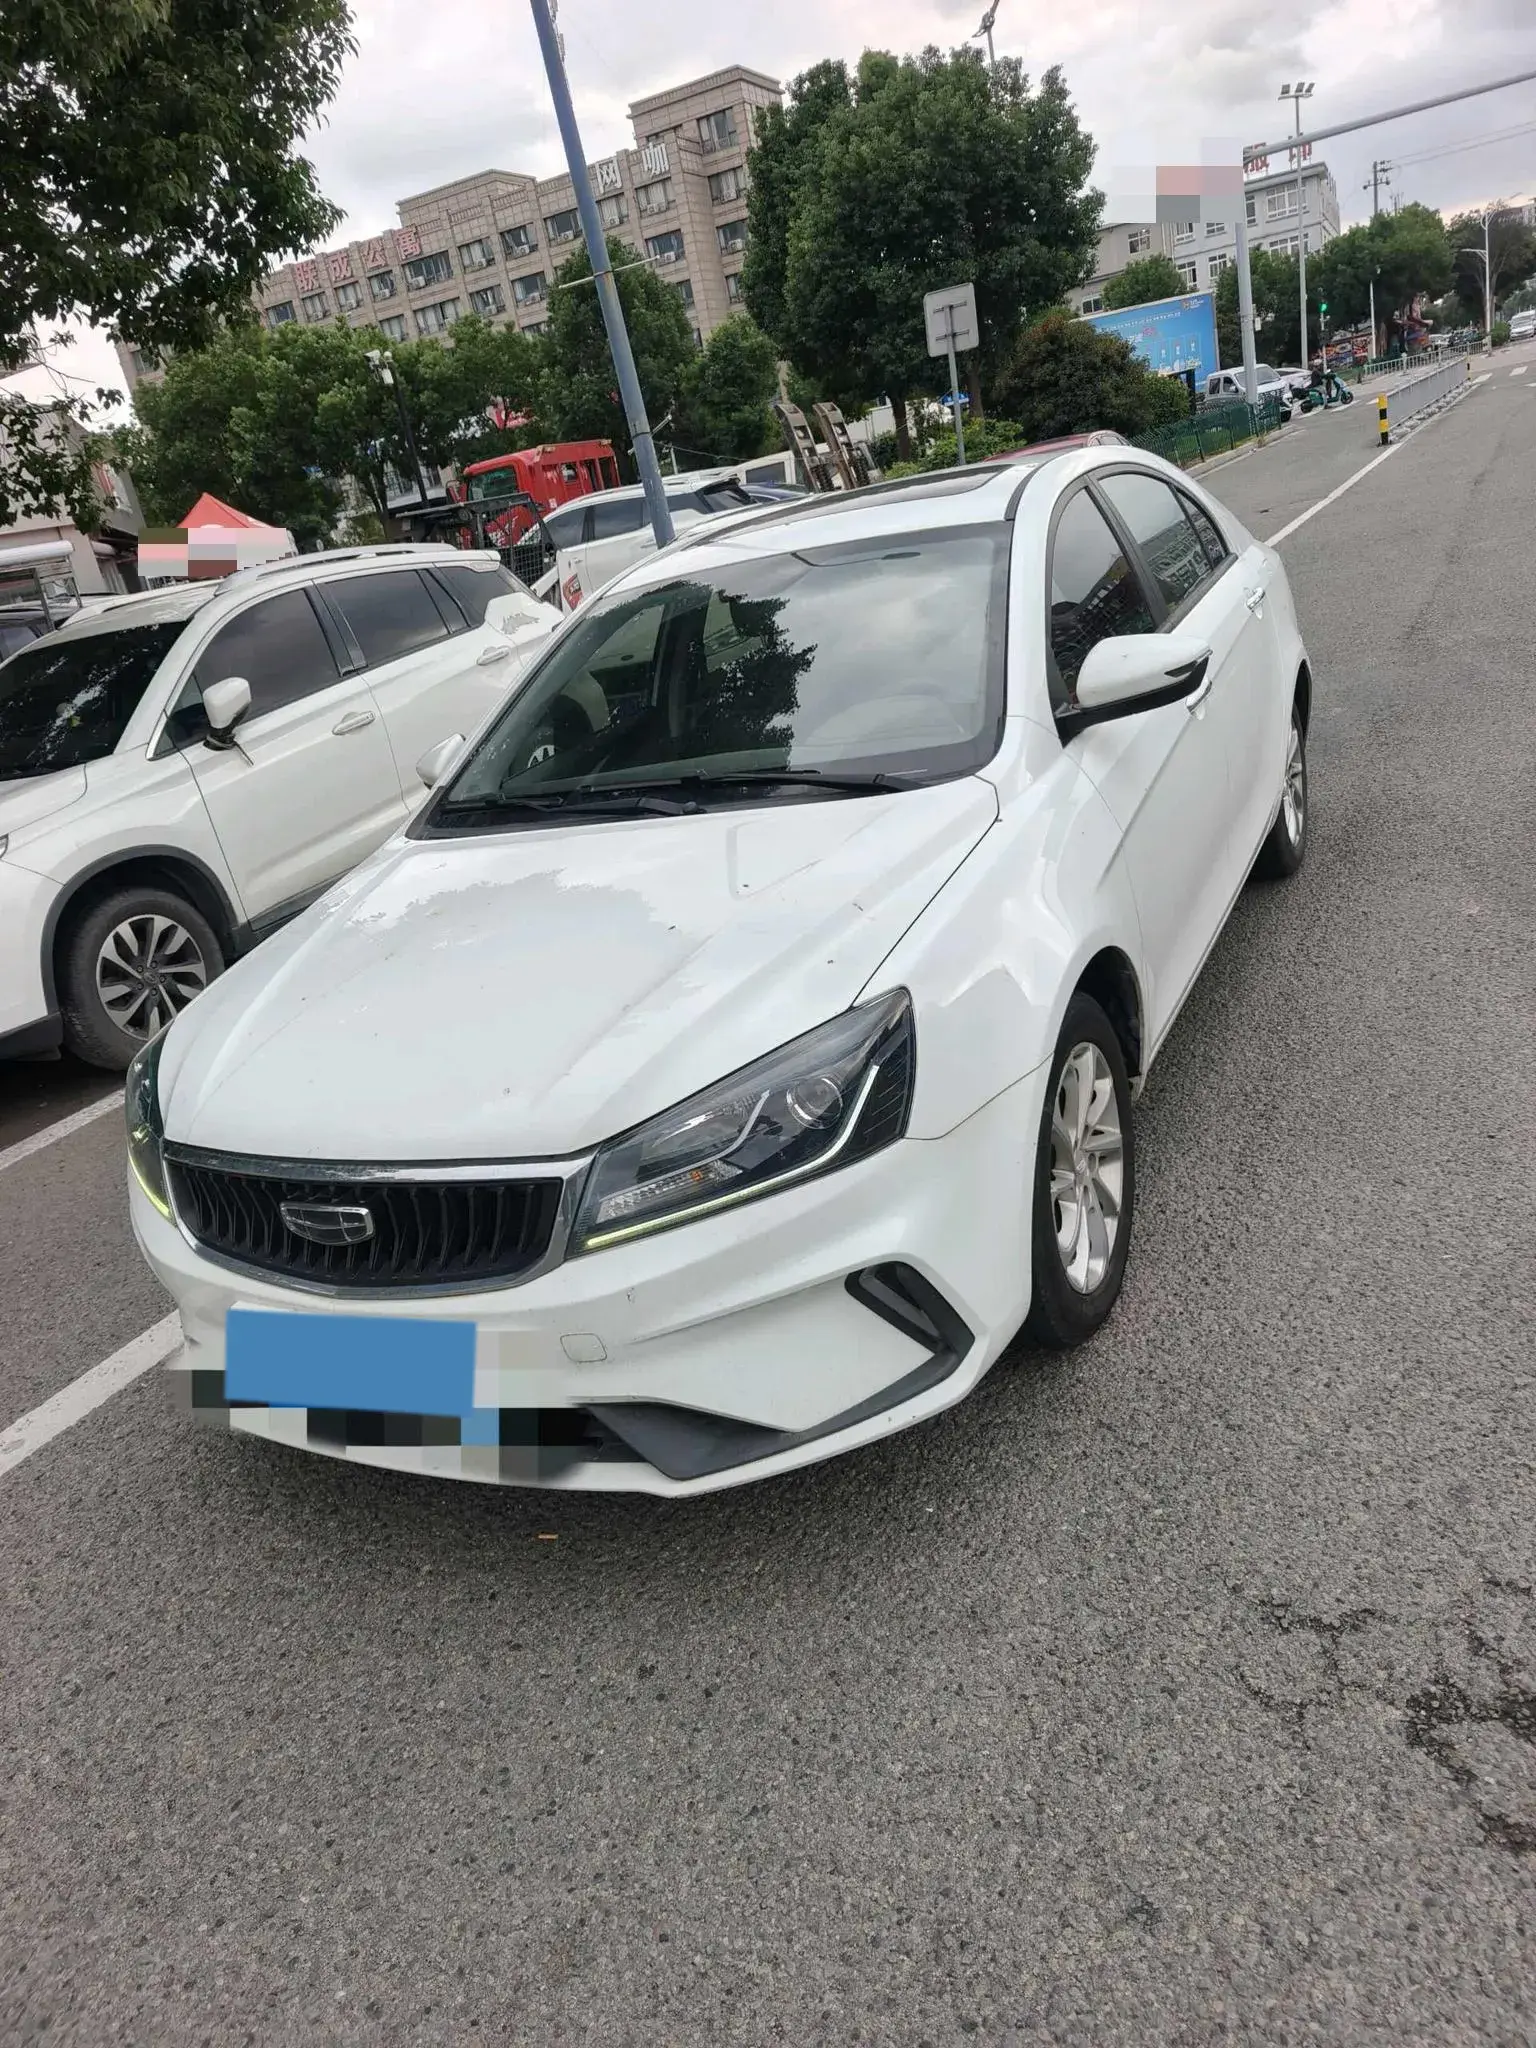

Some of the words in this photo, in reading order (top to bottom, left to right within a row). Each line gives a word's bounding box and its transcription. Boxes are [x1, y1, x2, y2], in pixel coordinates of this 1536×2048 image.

[595, 142, 670, 194] 网咖
[295, 224, 422, 291] 联成公寓
